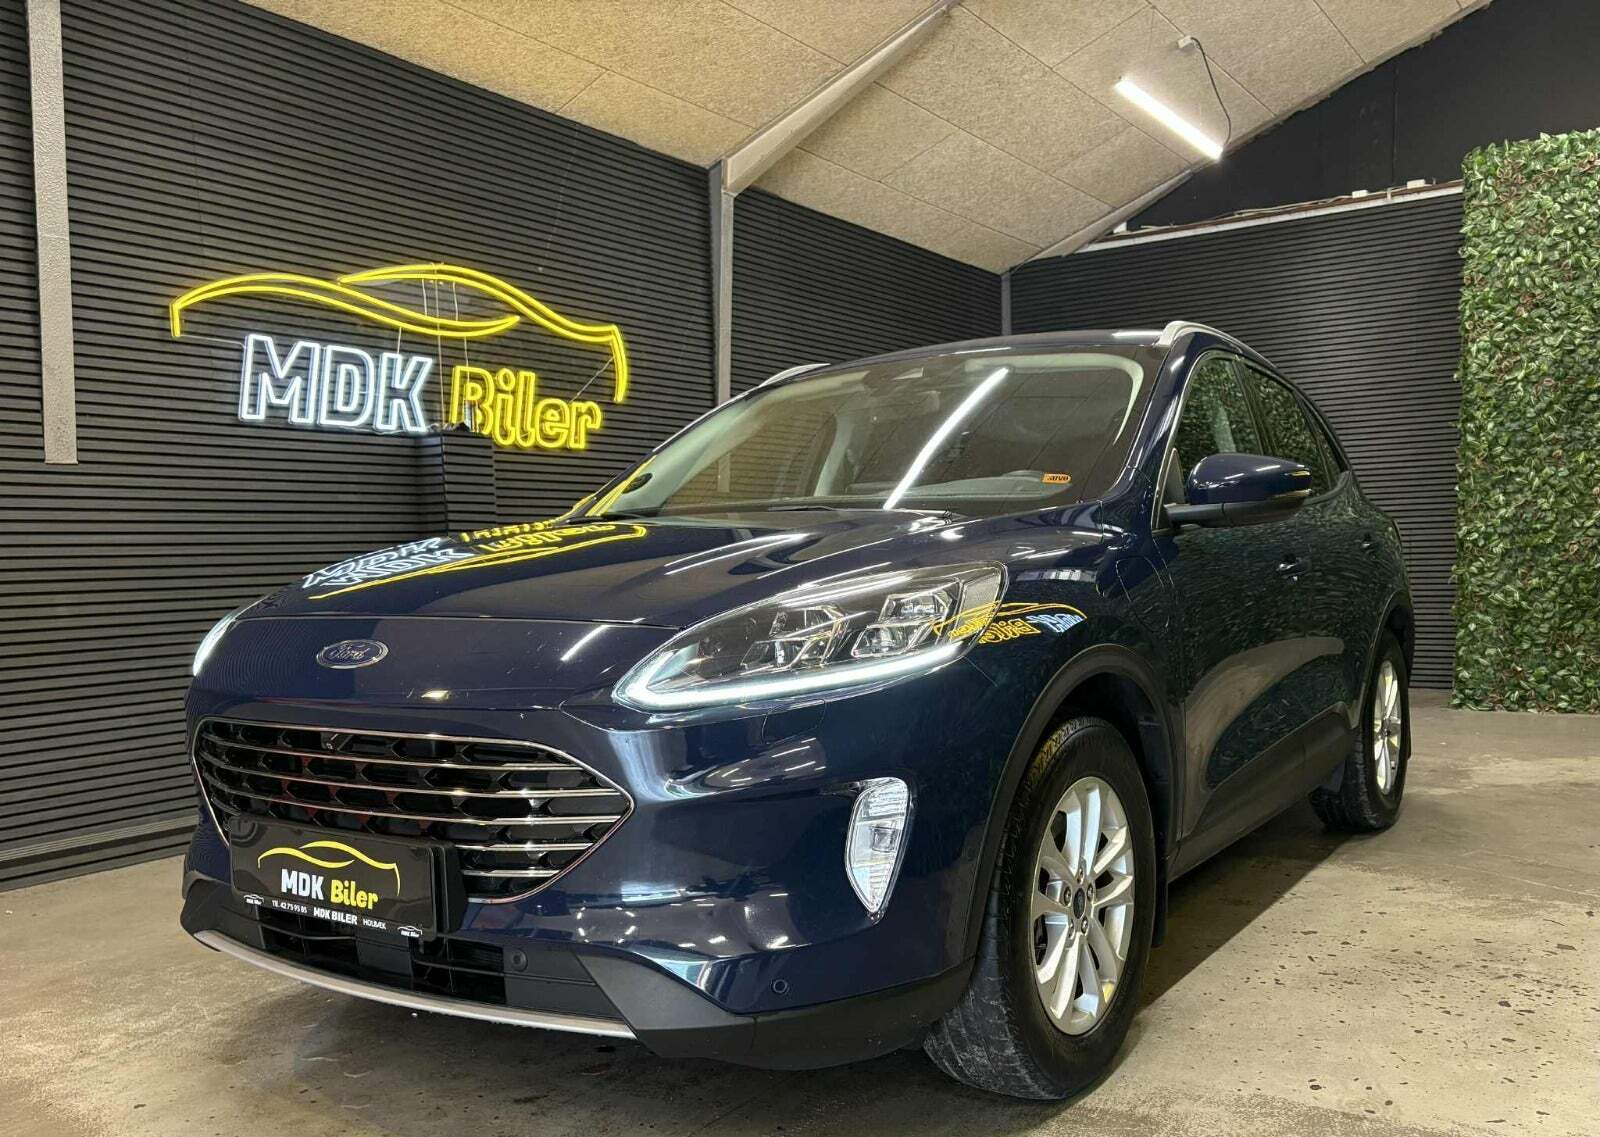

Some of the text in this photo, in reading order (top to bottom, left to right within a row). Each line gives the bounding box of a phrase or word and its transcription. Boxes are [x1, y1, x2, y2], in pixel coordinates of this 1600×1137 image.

[239, 333, 602, 449] MDK Biler
[281, 868, 379, 910] MDK Biler
[313, 906, 331, 920] MDK
[331, 910, 358, 926] BILER
